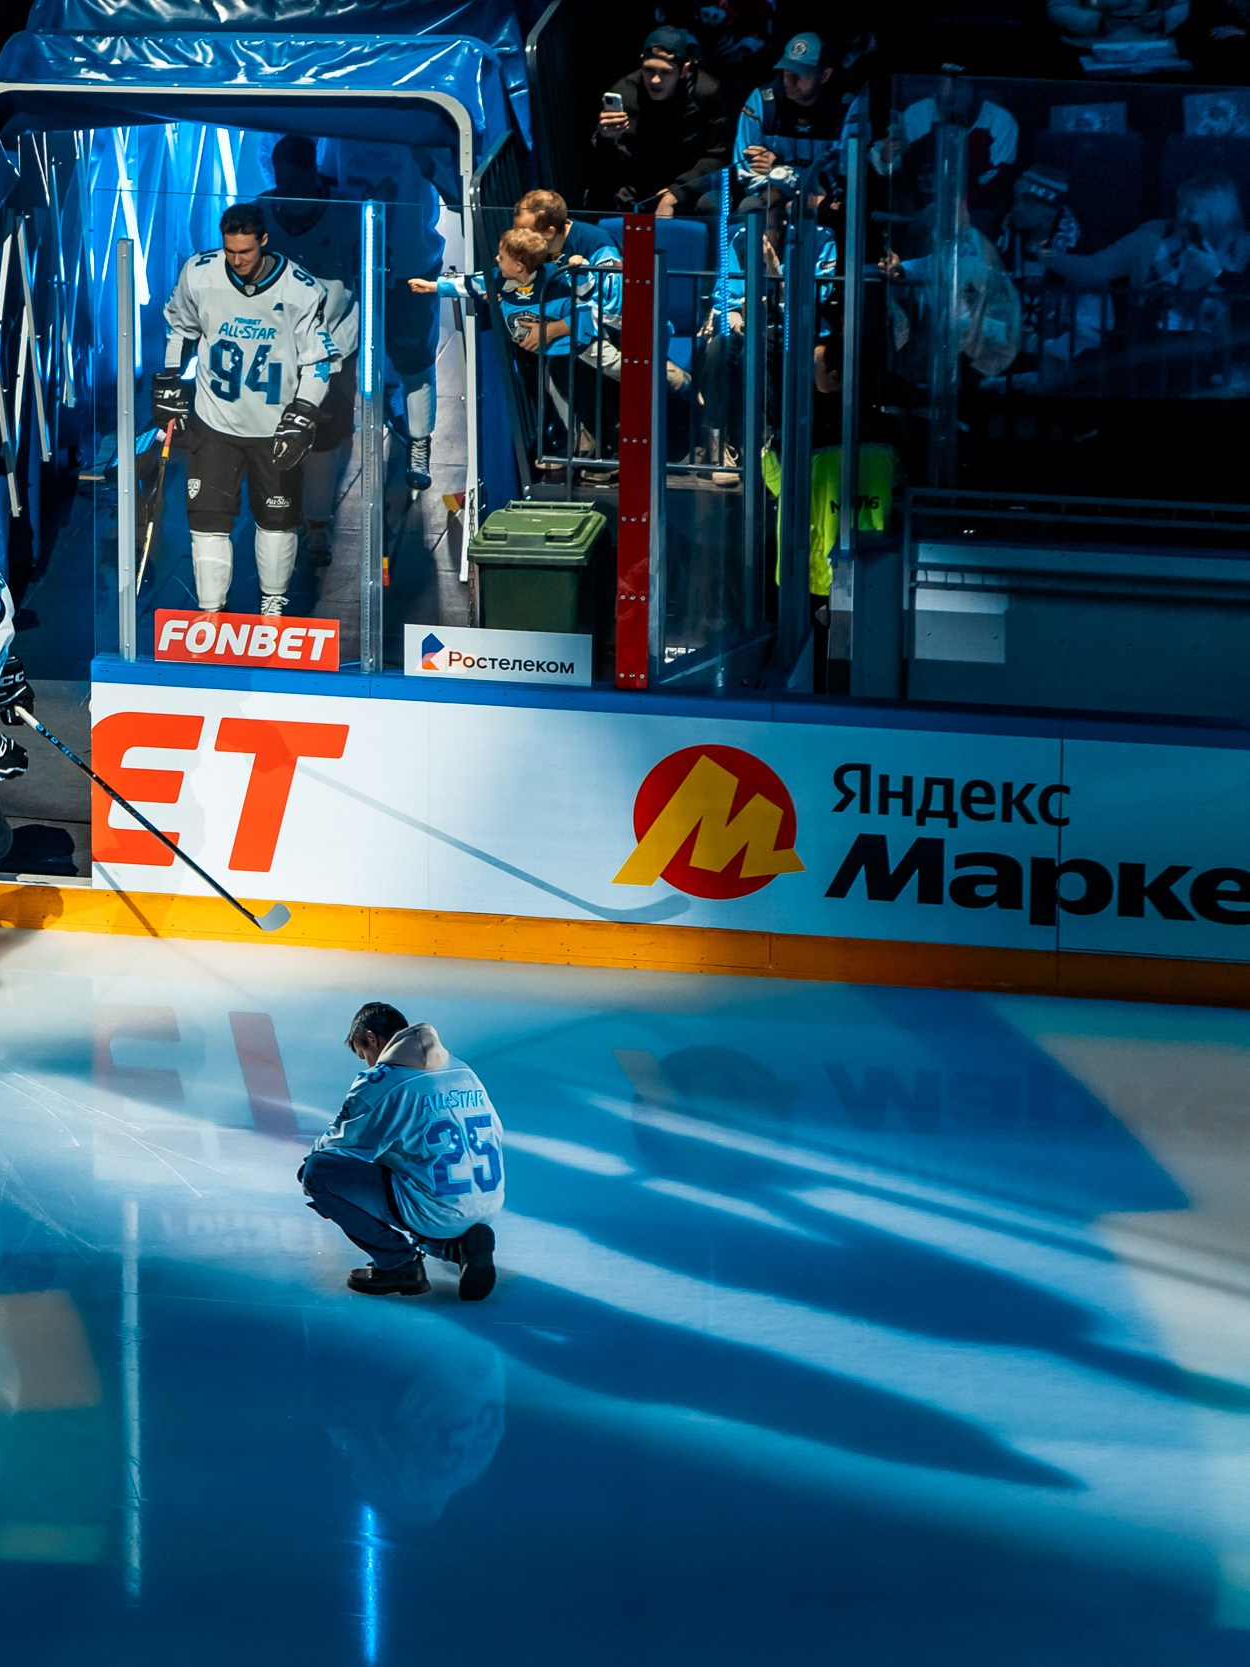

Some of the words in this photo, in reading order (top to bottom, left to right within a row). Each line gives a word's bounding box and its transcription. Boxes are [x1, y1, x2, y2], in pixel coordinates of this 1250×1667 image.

[209, 338, 283, 405] 94
[158, 619, 335, 661] FONBET
[448, 651, 575, 674] Ростелеком
[831, 763, 1071, 829] Яндекс
[824, 833, 1250, 926] Марке
[424, 1114, 502, 1198] 25
